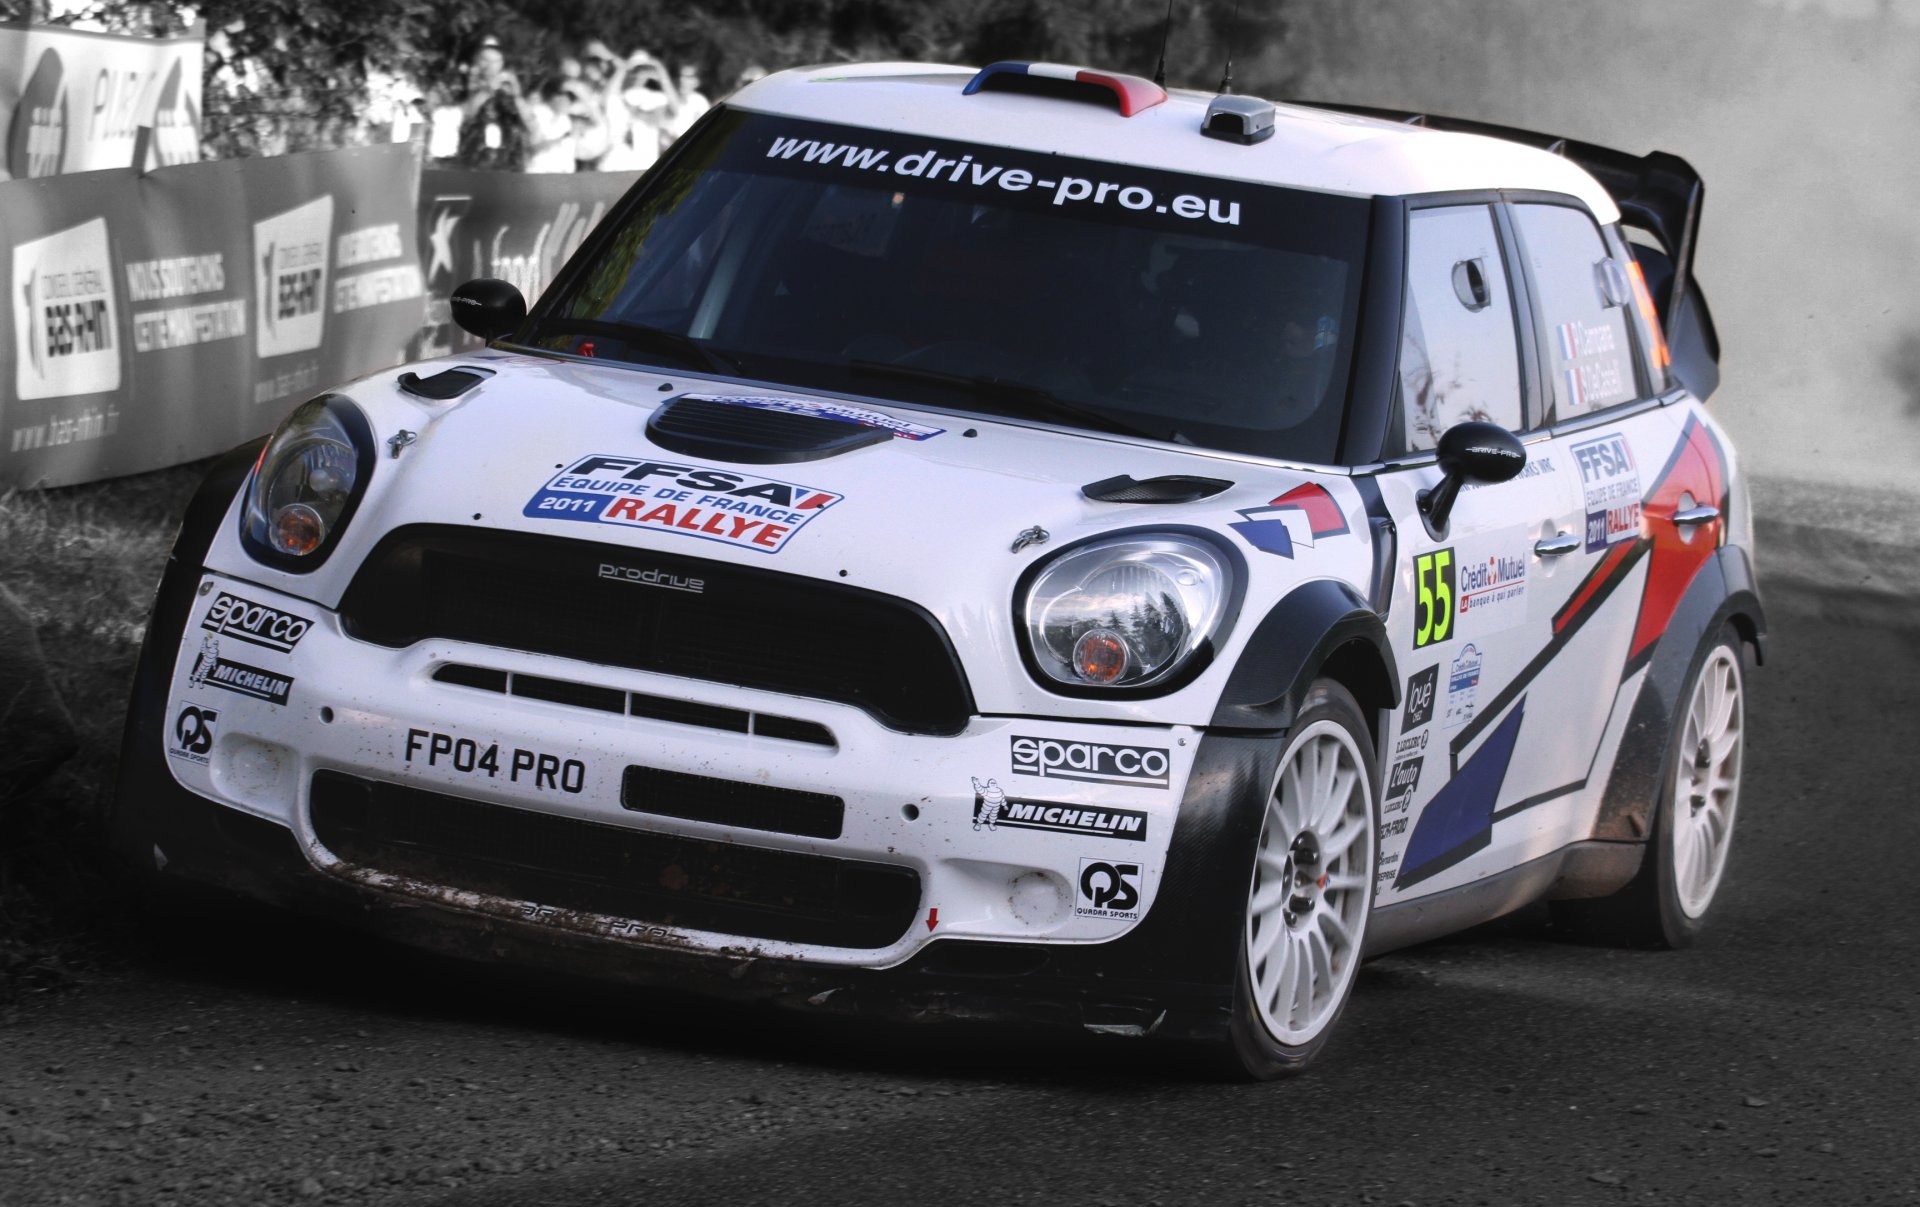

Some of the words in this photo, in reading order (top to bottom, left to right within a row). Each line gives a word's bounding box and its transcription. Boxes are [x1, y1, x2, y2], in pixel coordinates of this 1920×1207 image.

[766, 136, 1241, 226] www.drive-pro.eu
[569, 458, 793, 508] FFSA
[1575, 440, 1630, 484] FFSA
[537, 496, 600, 513] 2011
[605, 497, 790, 548] RALLYE
[554, 475, 651, 496] ÉQUIPE
[653, 487, 688, 502] DE
[698, 493, 806, 526] FRANCE
[1588, 517, 1605, 545] 2011
[1607, 502, 1640, 535] RALLYE
[1461, 563, 1488, 592] Crédit
[1497, 552, 1526, 584] Mutuel
[209, 596, 308, 642] sparco
[1416, 550, 1452, 646] 55
[213, 663, 289, 697] MICHELIN
[405, 728, 499, 778] FP04
[510, 748, 586, 794] PRO
[1012, 738, 1168, 777] sparco
[1007, 803, 1142, 832] MICHELIN
[1076, 907, 1107, 917] QUADRA
[1109, 910, 1139, 920] SPORTS
